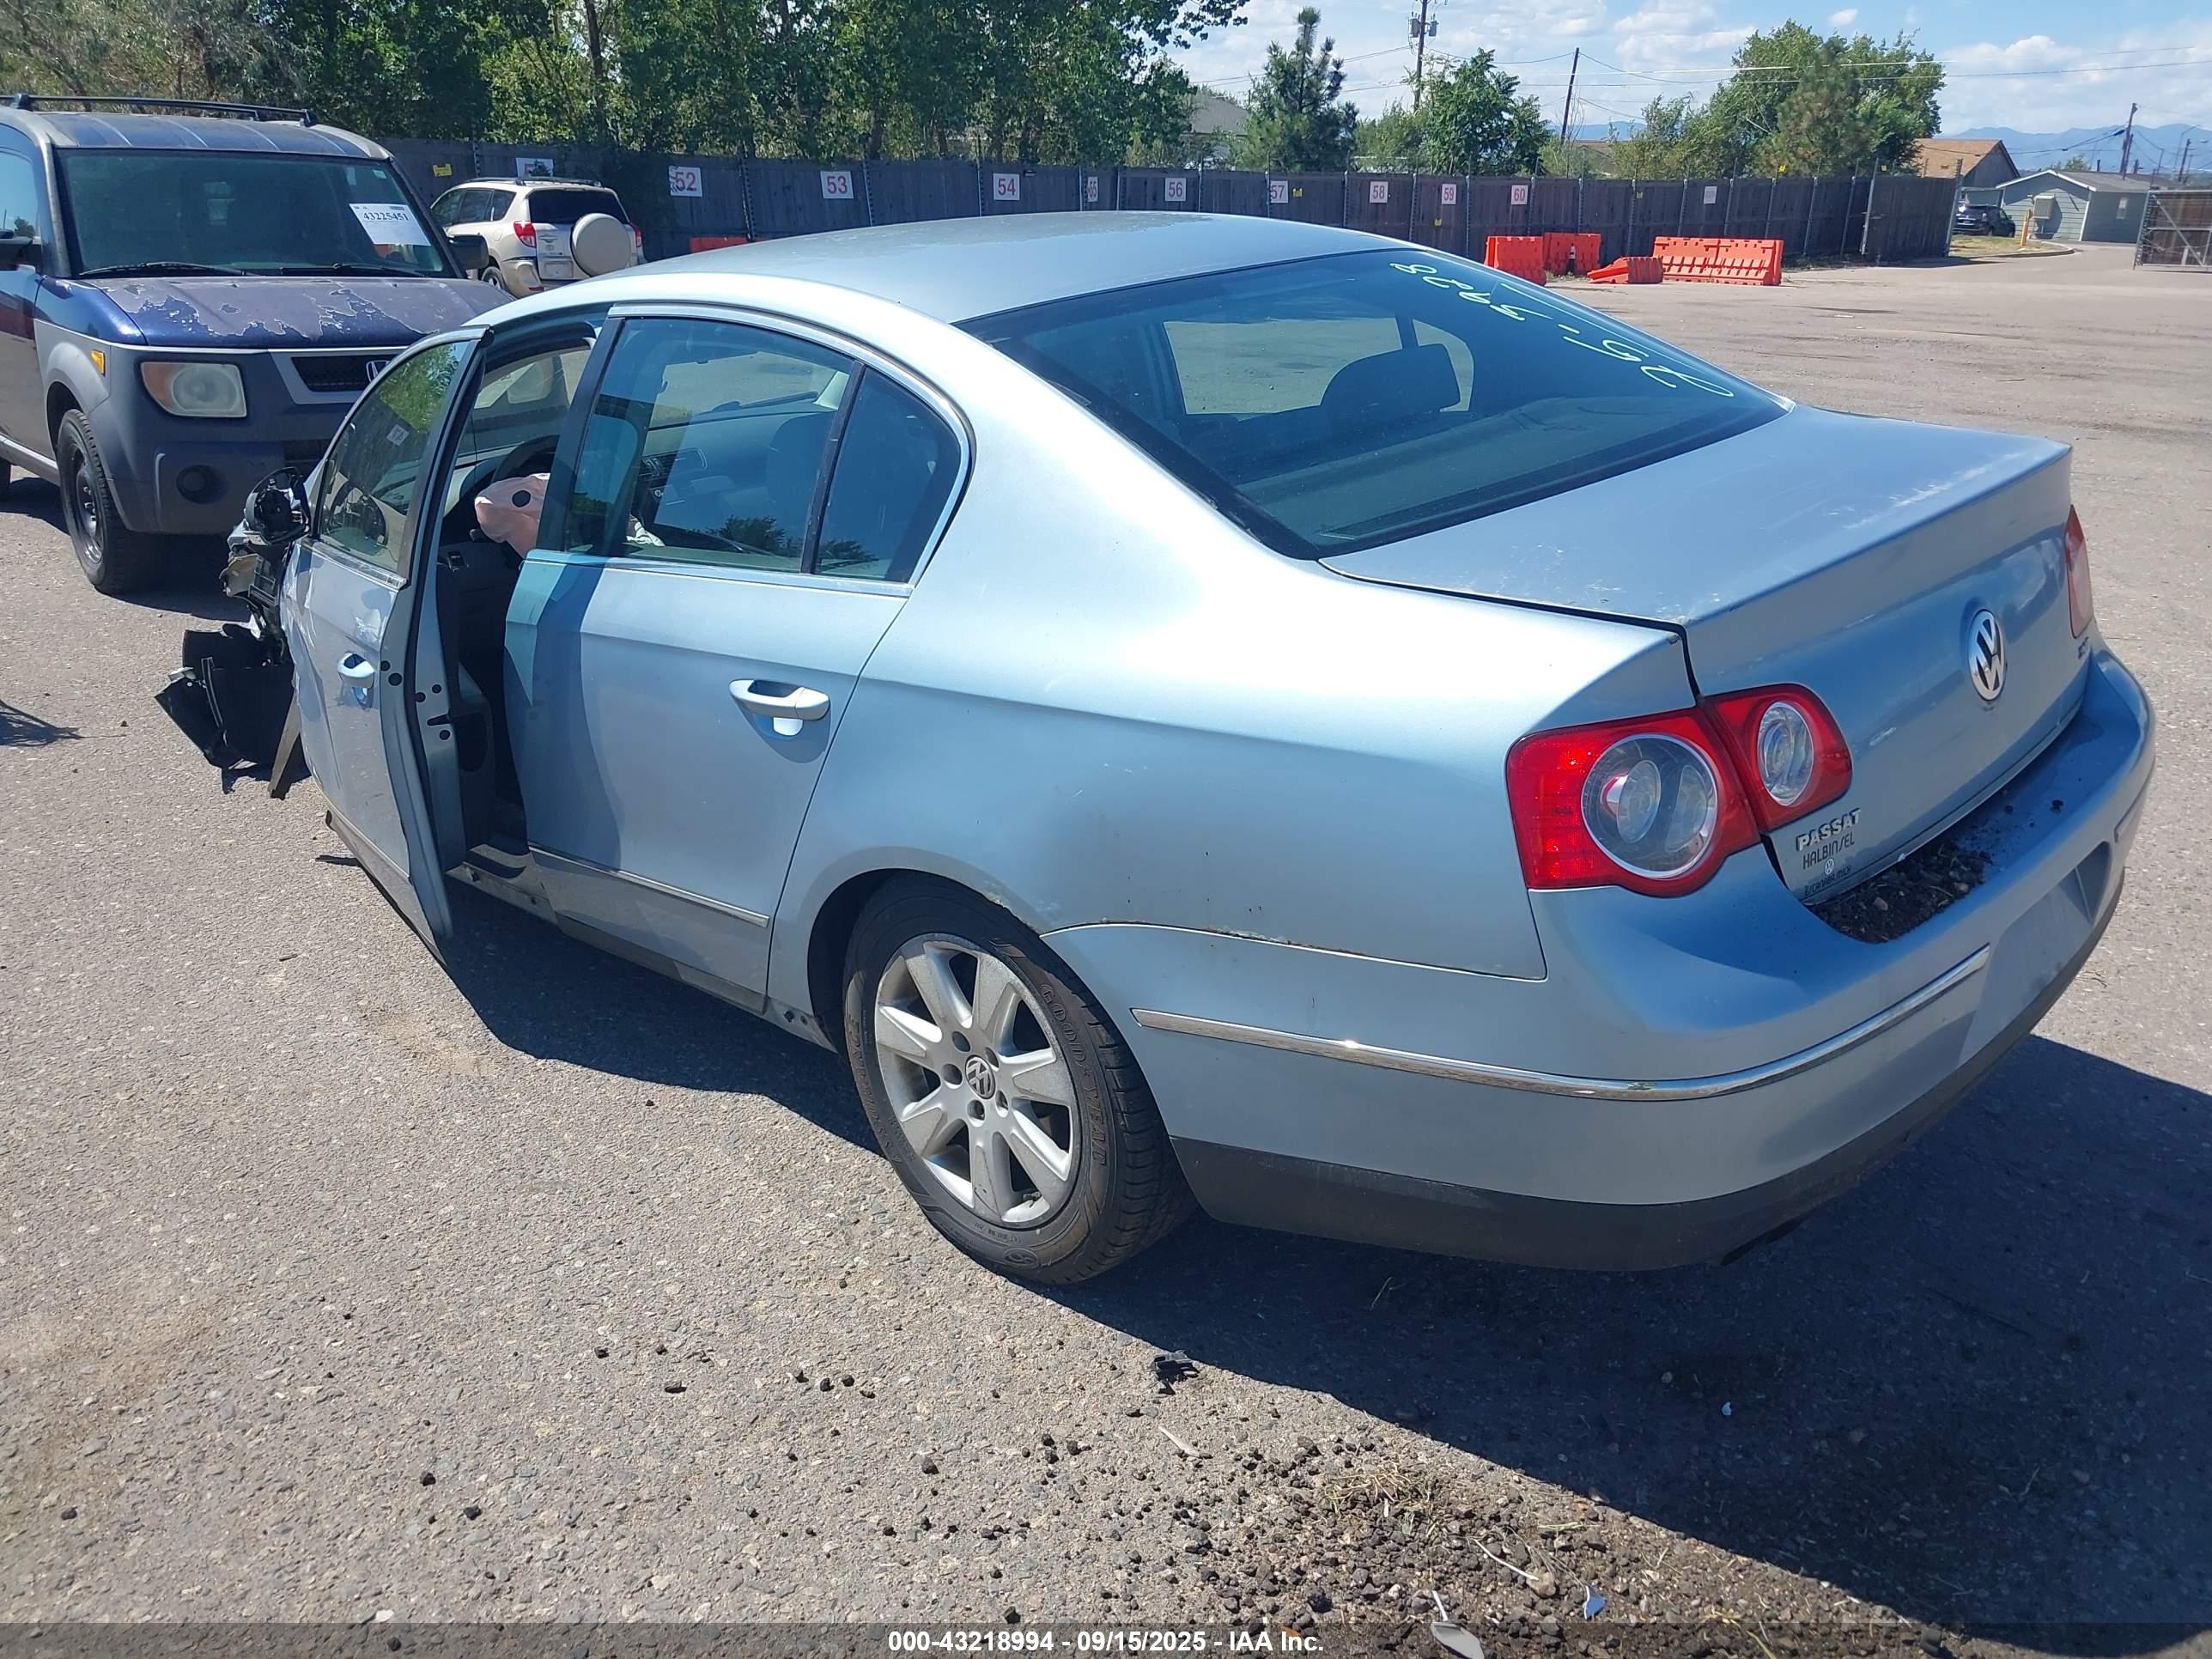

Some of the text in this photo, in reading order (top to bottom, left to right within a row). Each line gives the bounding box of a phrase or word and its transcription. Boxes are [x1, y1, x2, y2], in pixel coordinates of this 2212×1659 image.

[675, 172, 697, 191] 52
[827, 175, 848, 194] 53
[998, 178, 1016, 196] 54
[1168, 181, 1183, 198] 56
[1271, 185, 1285, 199] 57
[1372, 185, 1385, 199] 58
[1443, 187, 1455, 201] 59
[1513, 188, 1526, 201] 60
[363, 212, 409, 221] 43225451
[1796, 808, 1862, 852] PASSAT
[1802, 830, 1855, 870] HALBINSEL
